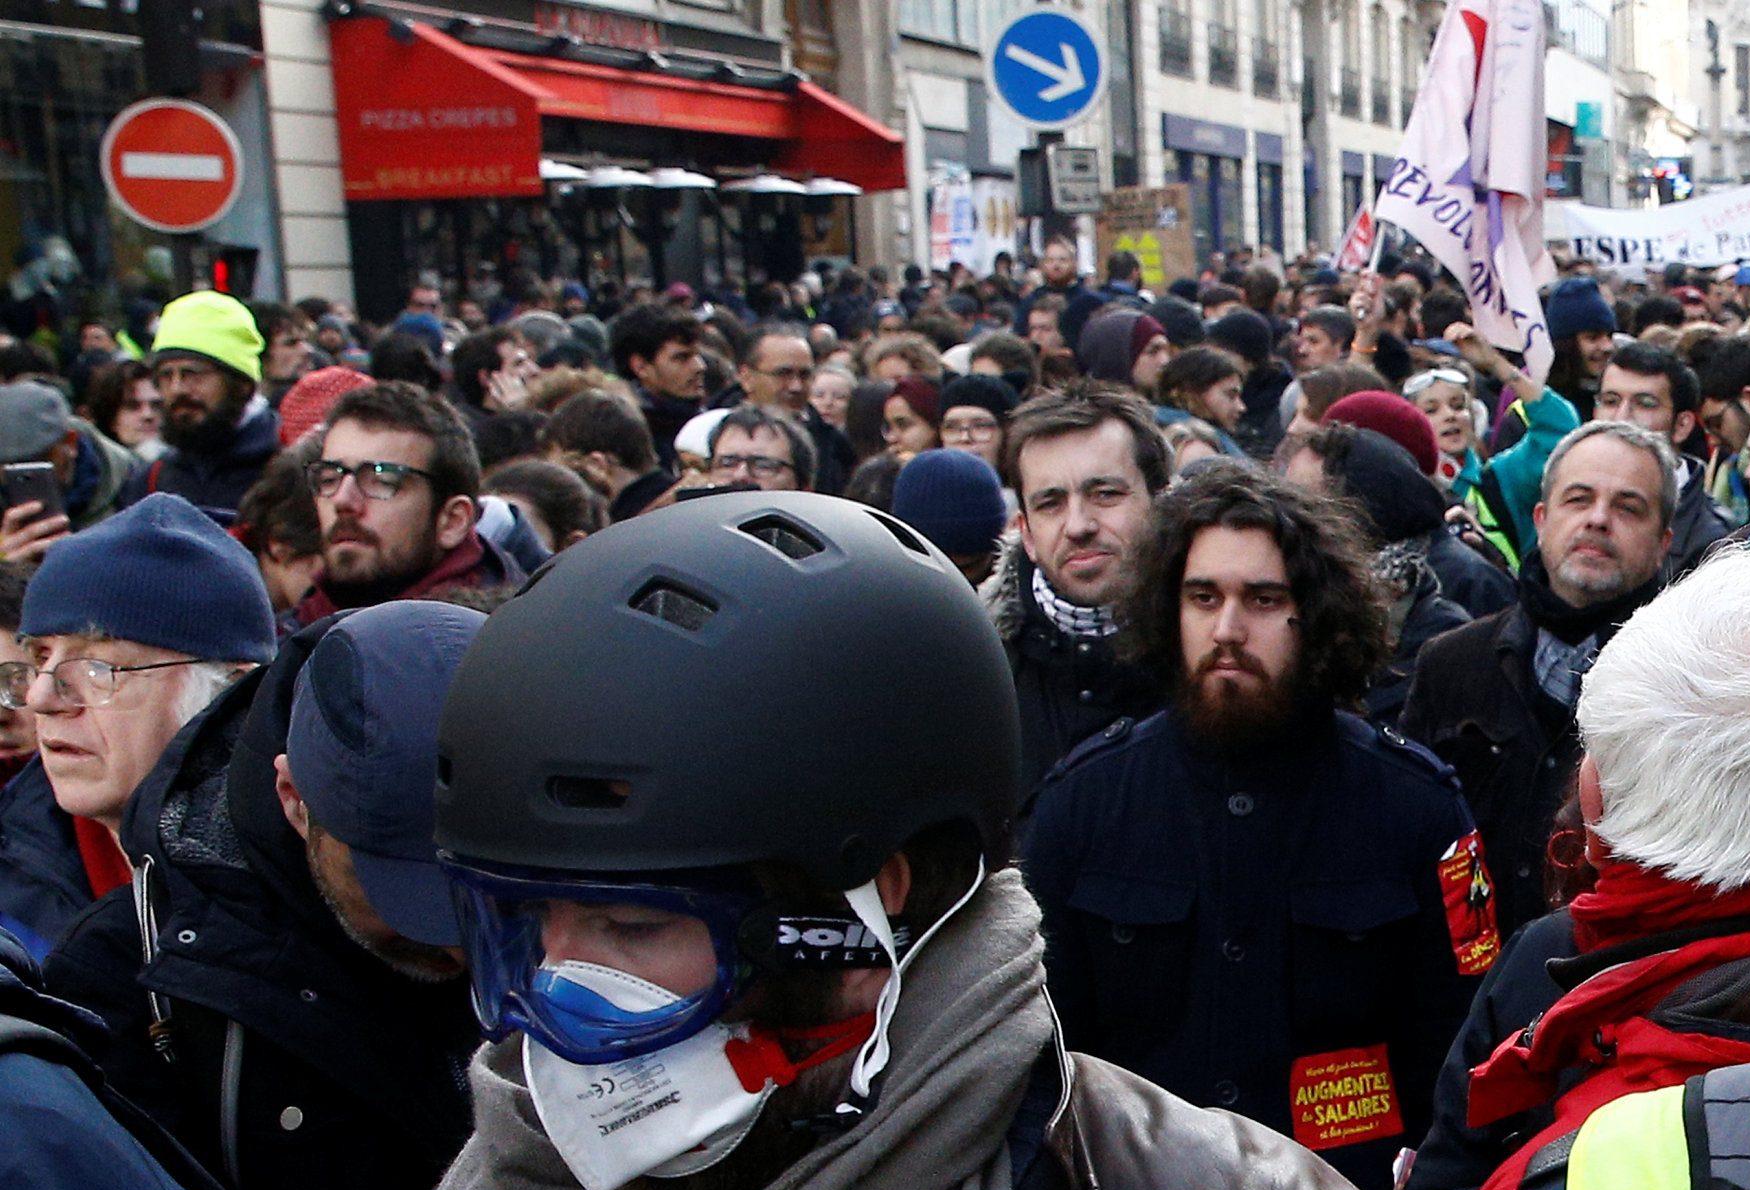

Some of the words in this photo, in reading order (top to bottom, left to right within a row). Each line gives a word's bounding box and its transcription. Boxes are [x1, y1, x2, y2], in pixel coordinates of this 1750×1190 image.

[360, 109, 424, 129] PIZZA
[427, 107, 518, 128] CREPES
[376, 165, 514, 189] BREAKFAST
[1571, 236, 1665, 265] ESPE
[1678, 239, 1705, 259] de
[1315, 1094, 1390, 1126] SALAIRES
